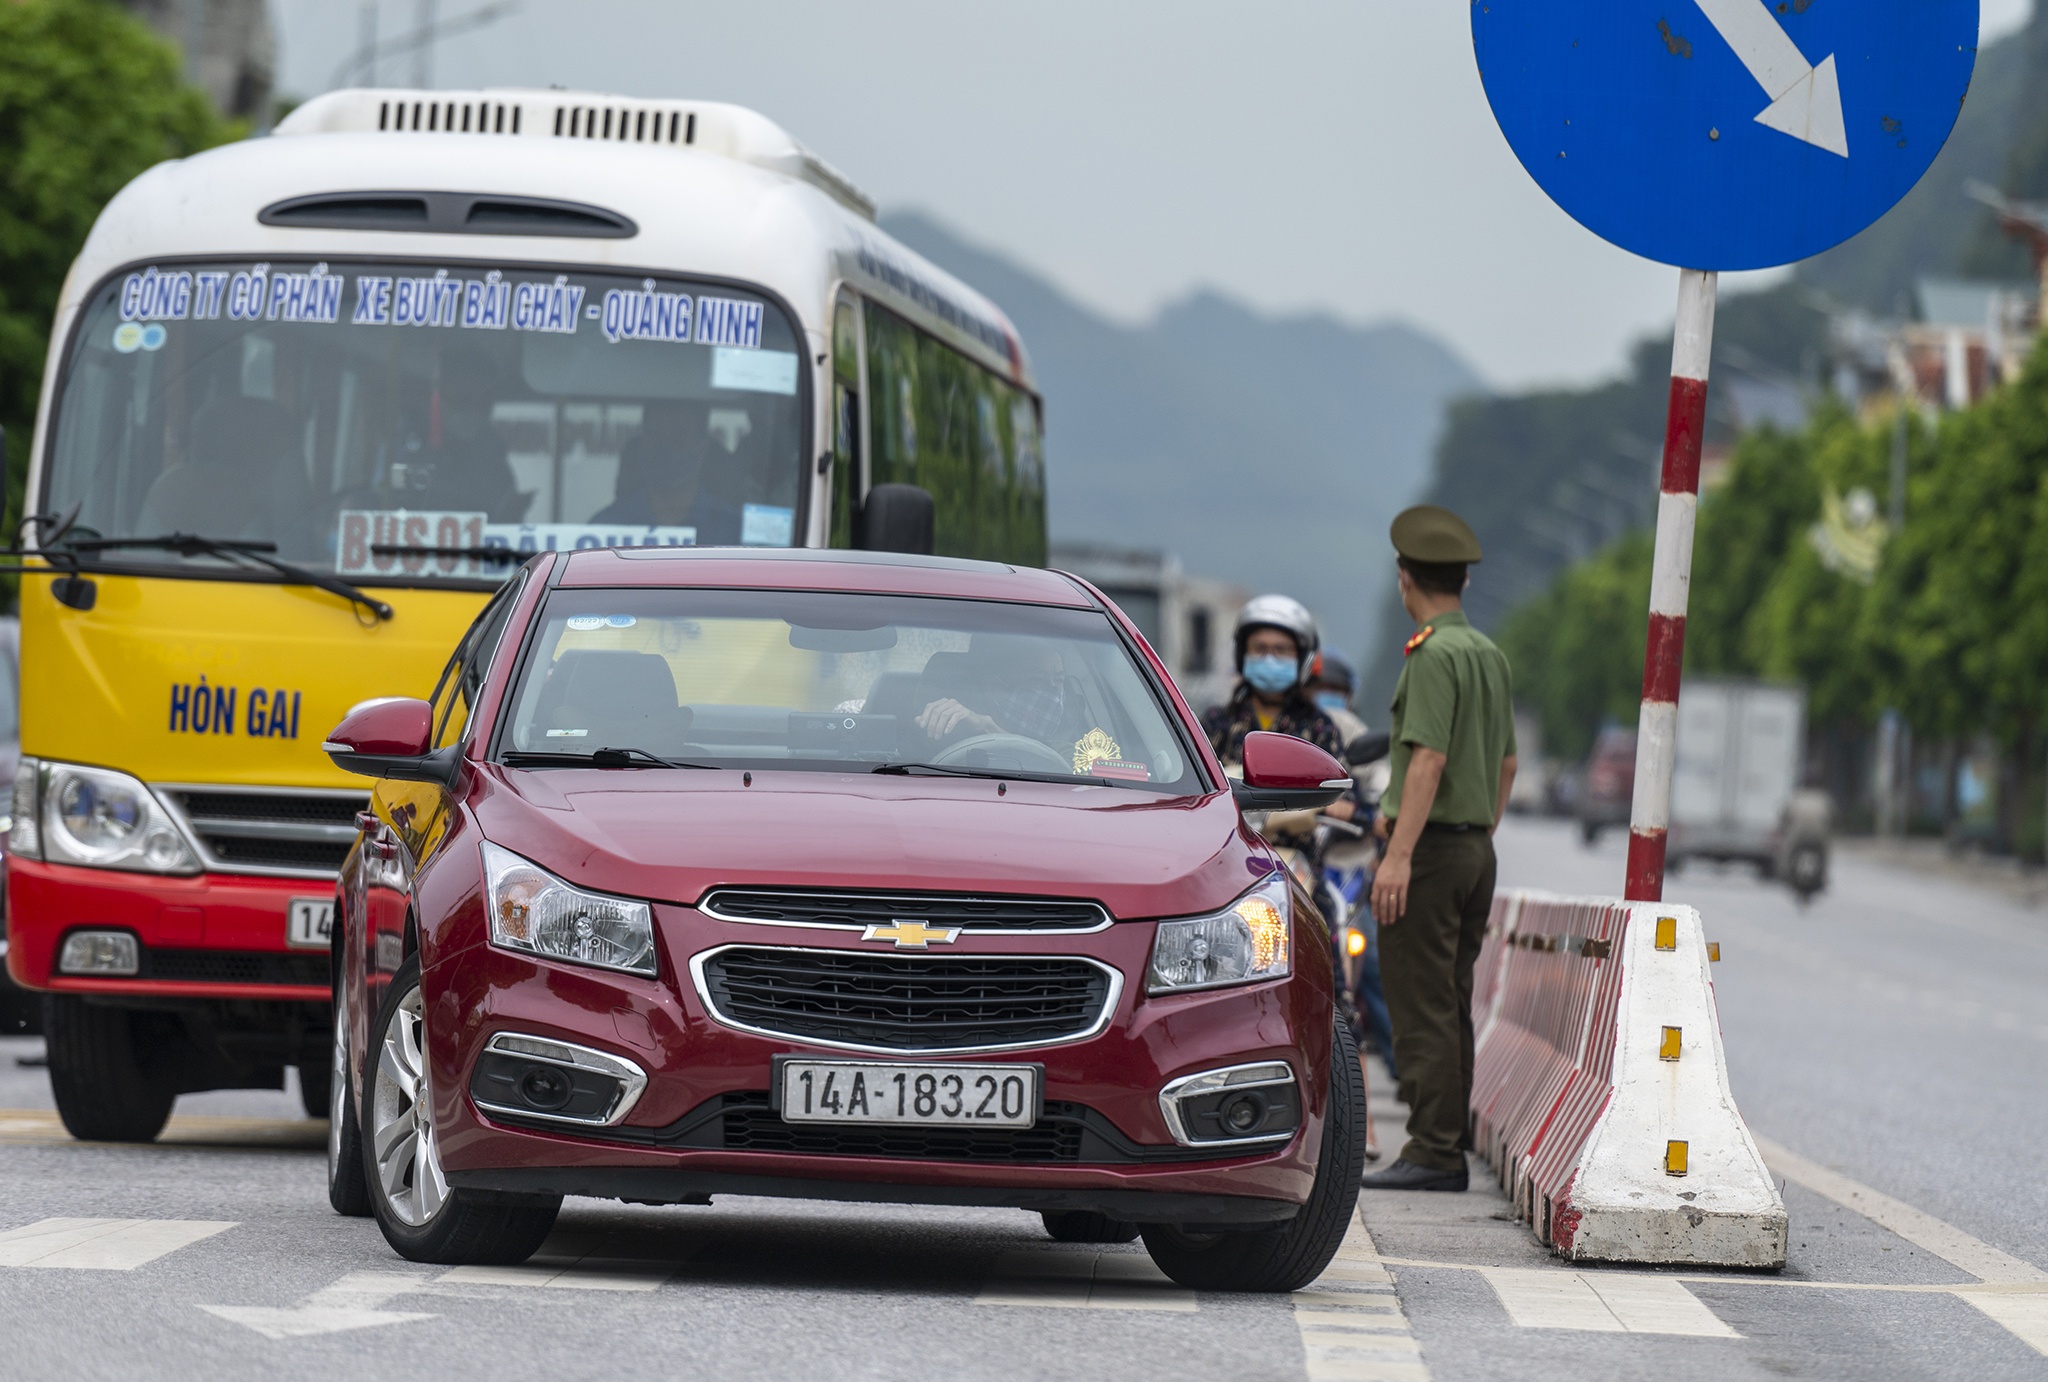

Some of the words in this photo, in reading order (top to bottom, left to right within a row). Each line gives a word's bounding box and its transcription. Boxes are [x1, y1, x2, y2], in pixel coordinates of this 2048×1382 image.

[120, 266, 192, 321] CÔNG
[194, 272, 229, 320] TY
[352, 276, 393, 325] XE
[392, 269, 463, 327] BUÝT
[512, 275, 586, 334] CHÁY
[602, 278, 694, 343] QUẢNG
[695, 296, 764, 349] NINH
[342, 514, 429, 573] BUS
[437, 516, 483, 573] 01
[169, 674, 237, 735] HÒN
[247, 686, 302, 739] GAI
[799, 1069, 1025, 1119] 14A-183.20
